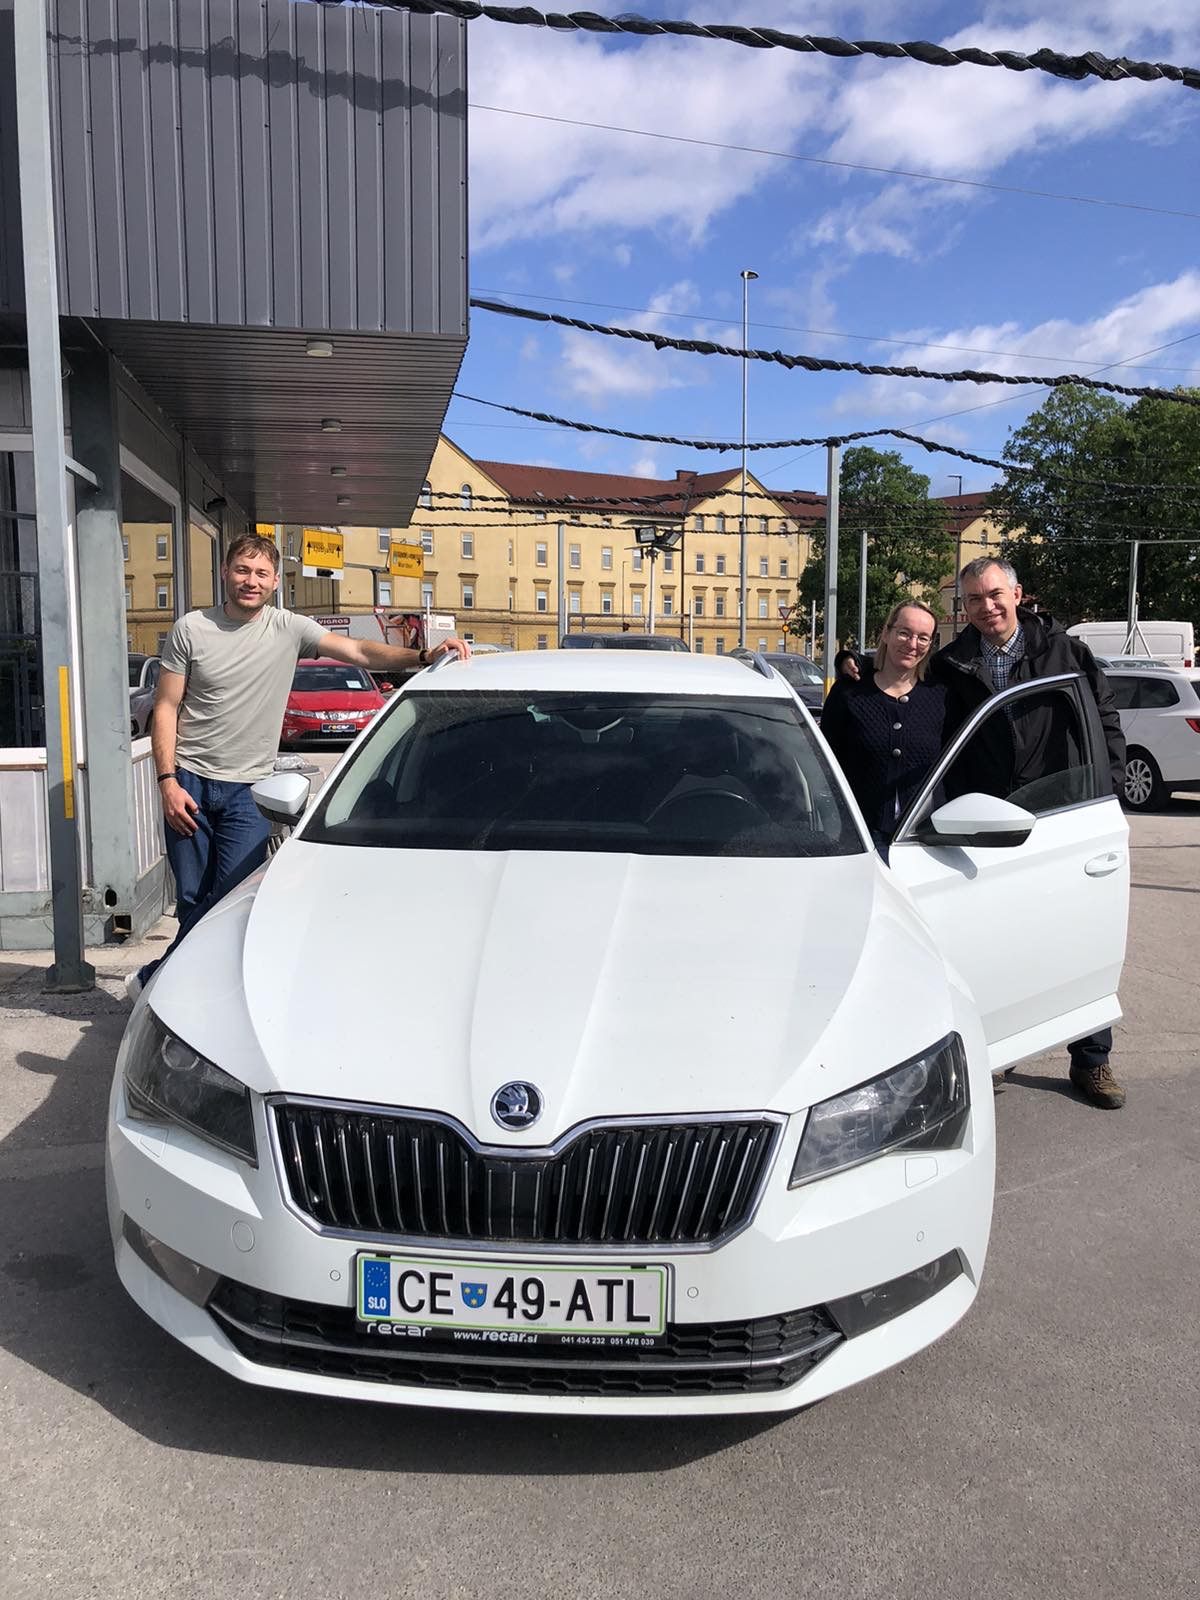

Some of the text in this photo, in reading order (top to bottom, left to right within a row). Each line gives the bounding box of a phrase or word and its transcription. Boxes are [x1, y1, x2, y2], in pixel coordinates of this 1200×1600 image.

[367, 1296, 387, 1310] SLO
[398, 1269, 651, 1323] CE 49-ATL
[367, 1323, 432, 1337] recar
[453, 1331, 538, 1343] www.recar.si
[561, 1336, 574, 1344] 041
[576, 1337, 590, 1345] 434
[592, 1337, 606, 1345] 232
[610, 1338, 624, 1346] 051
[641, 1338, 655, 1346] 039
